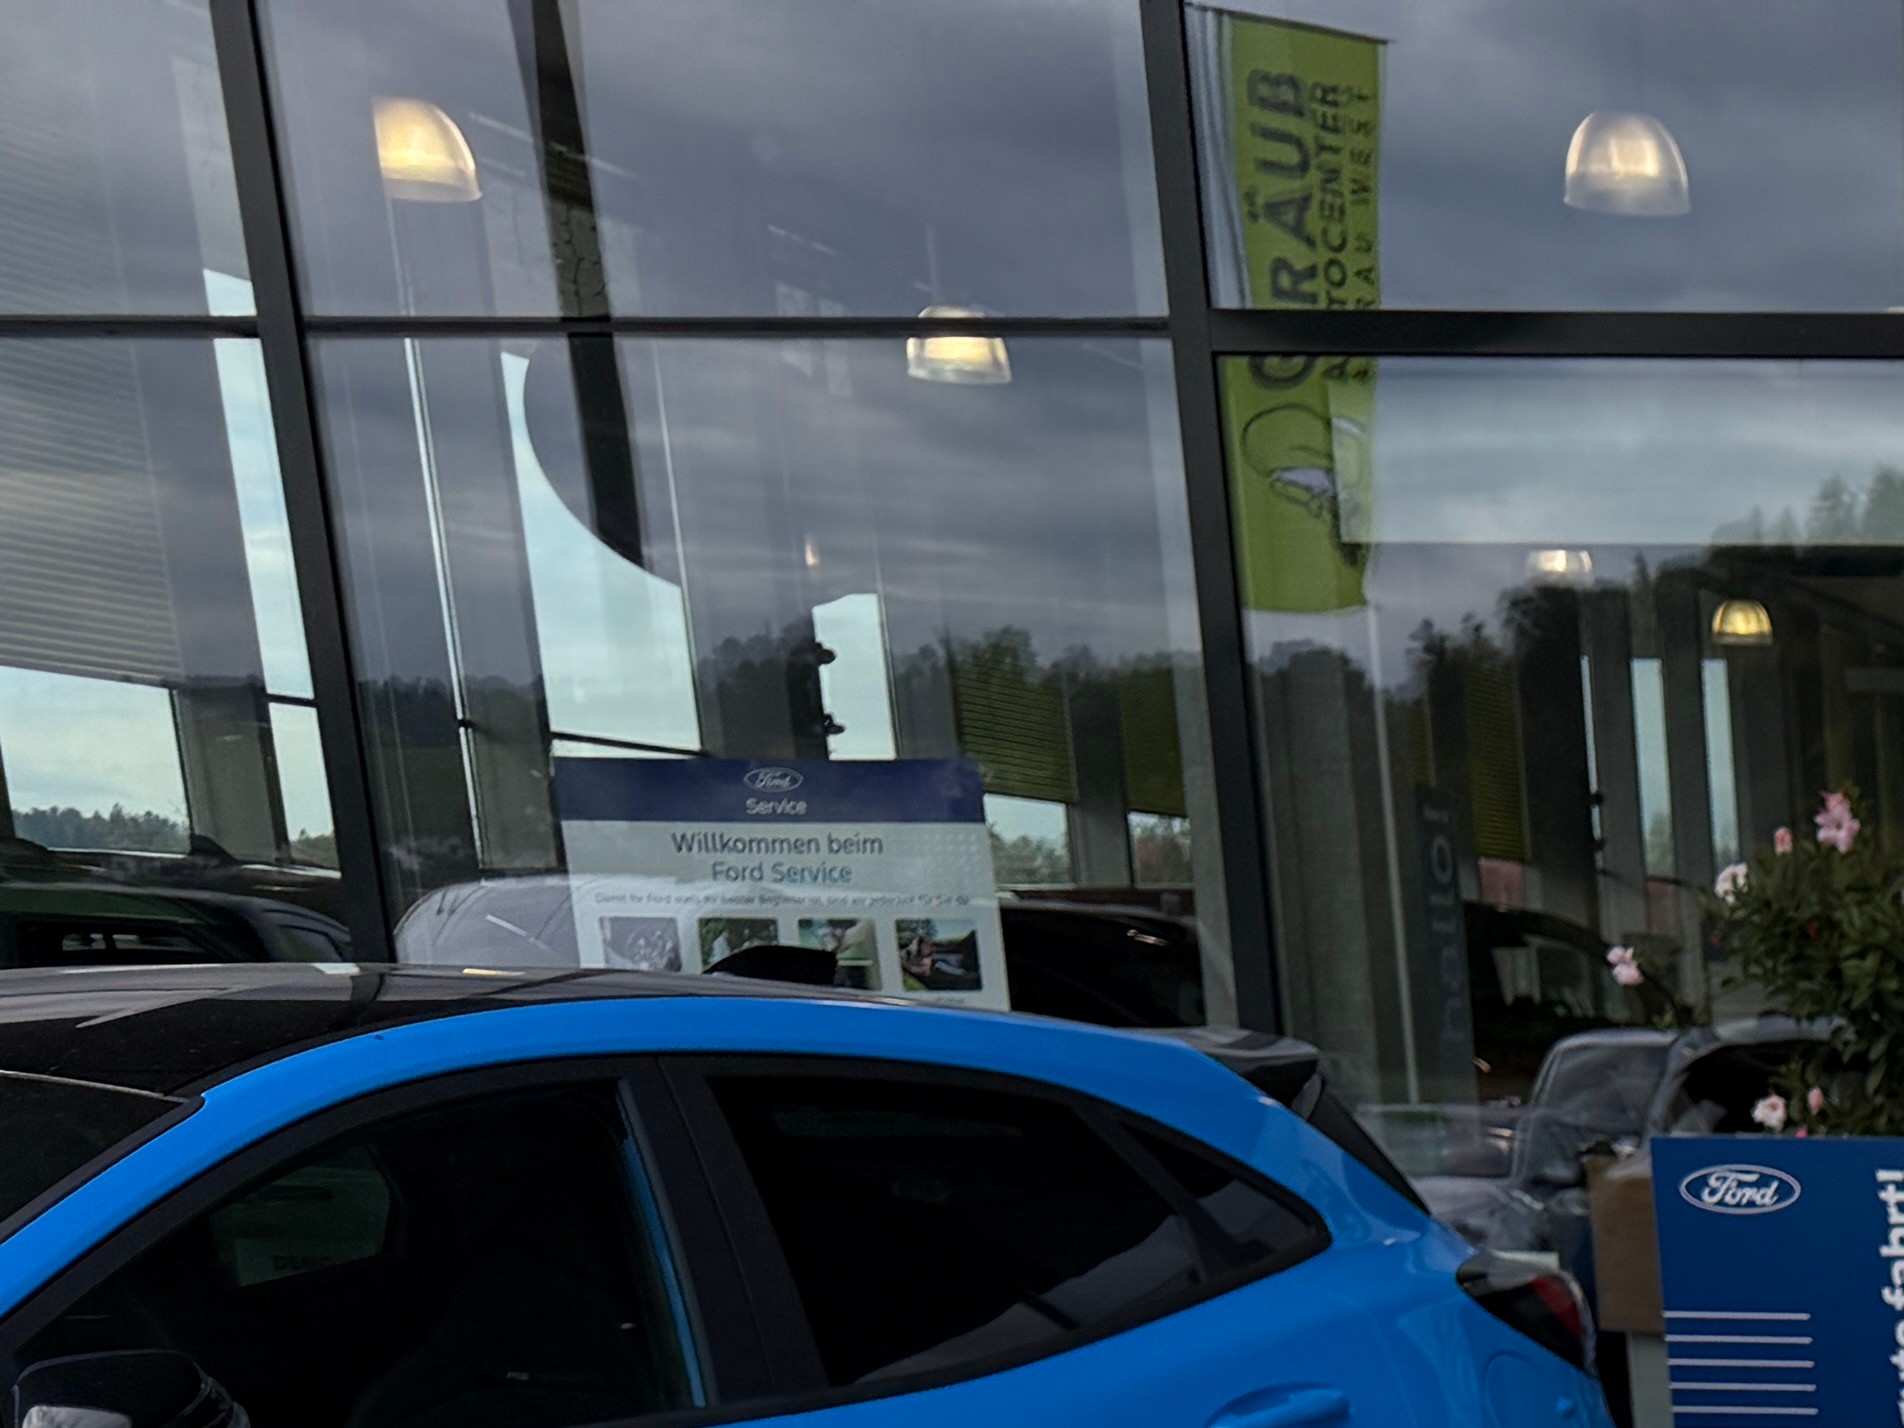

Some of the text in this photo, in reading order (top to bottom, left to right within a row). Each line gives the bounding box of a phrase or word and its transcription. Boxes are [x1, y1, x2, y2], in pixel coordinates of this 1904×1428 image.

[1311, 81, 1351, 380] ATOCENTER
[745, 797, 808, 816] Service
[671, 831, 884, 856] Willkommen beim
[711, 861, 852, 884] Ford Service
[1702, 1169, 1779, 1208] Ford
